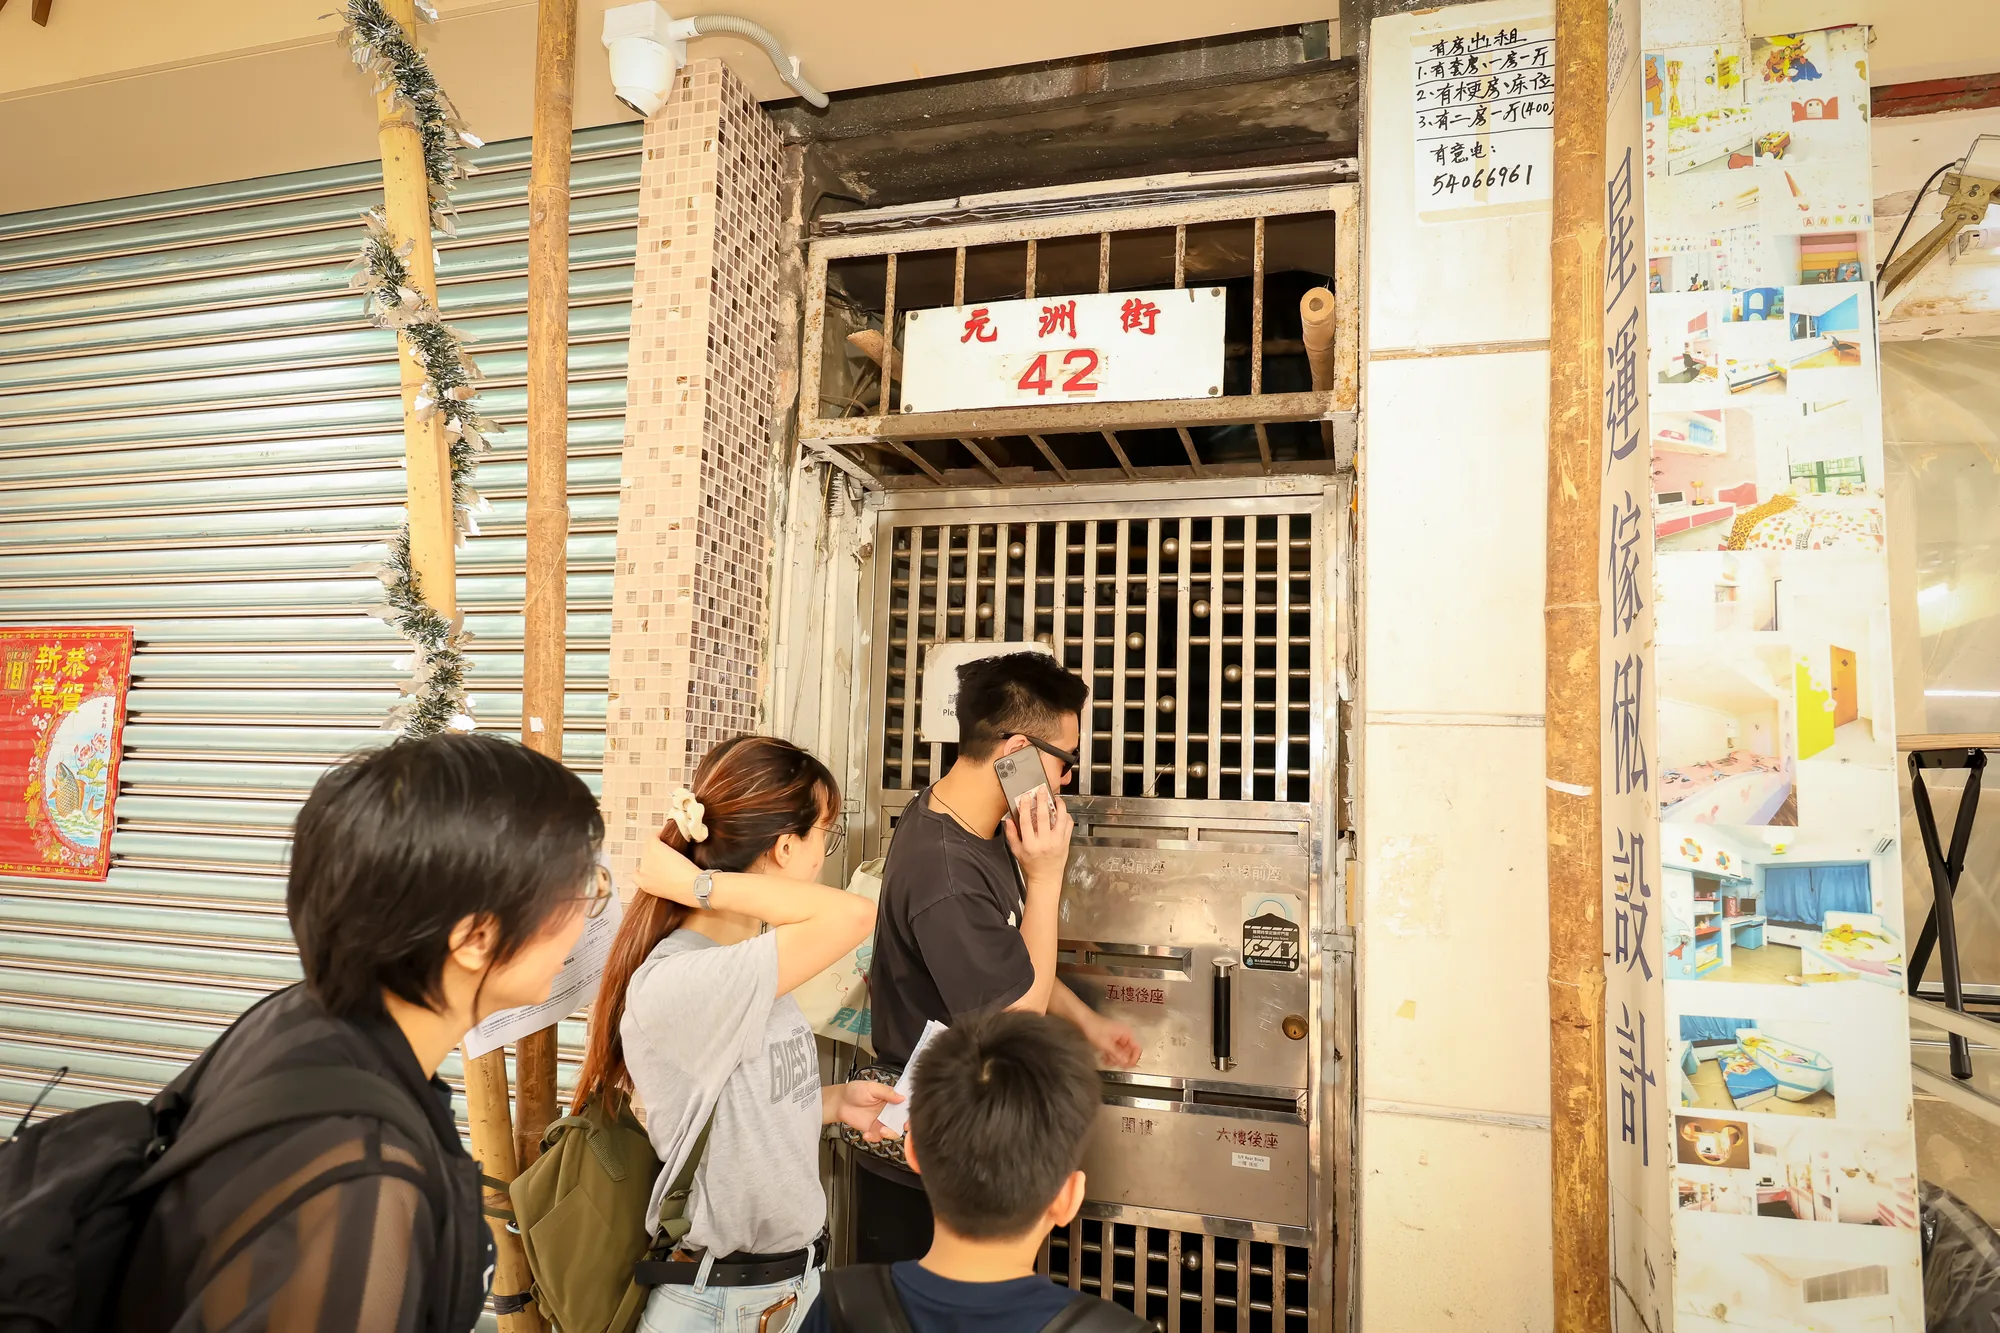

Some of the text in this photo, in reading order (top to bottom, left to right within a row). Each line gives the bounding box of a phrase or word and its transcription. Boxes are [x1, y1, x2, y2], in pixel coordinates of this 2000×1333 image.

[1429, 28, 1527, 57] 有房出租
[1432, 164, 1533, 196] 54066961
[960, 297, 1161, 343] 元洲街
[1017, 349, 1099, 395] 42
[1605, 146, 1656, 1167] 星運傢俬設計
[942, 708, 957, 716] Ple
[1107, 984, 1164, 1005] 五樓後座
[769, 1035, 808, 1105] GUESS
[1216, 1127, 1279, 1150] 六樓後座
